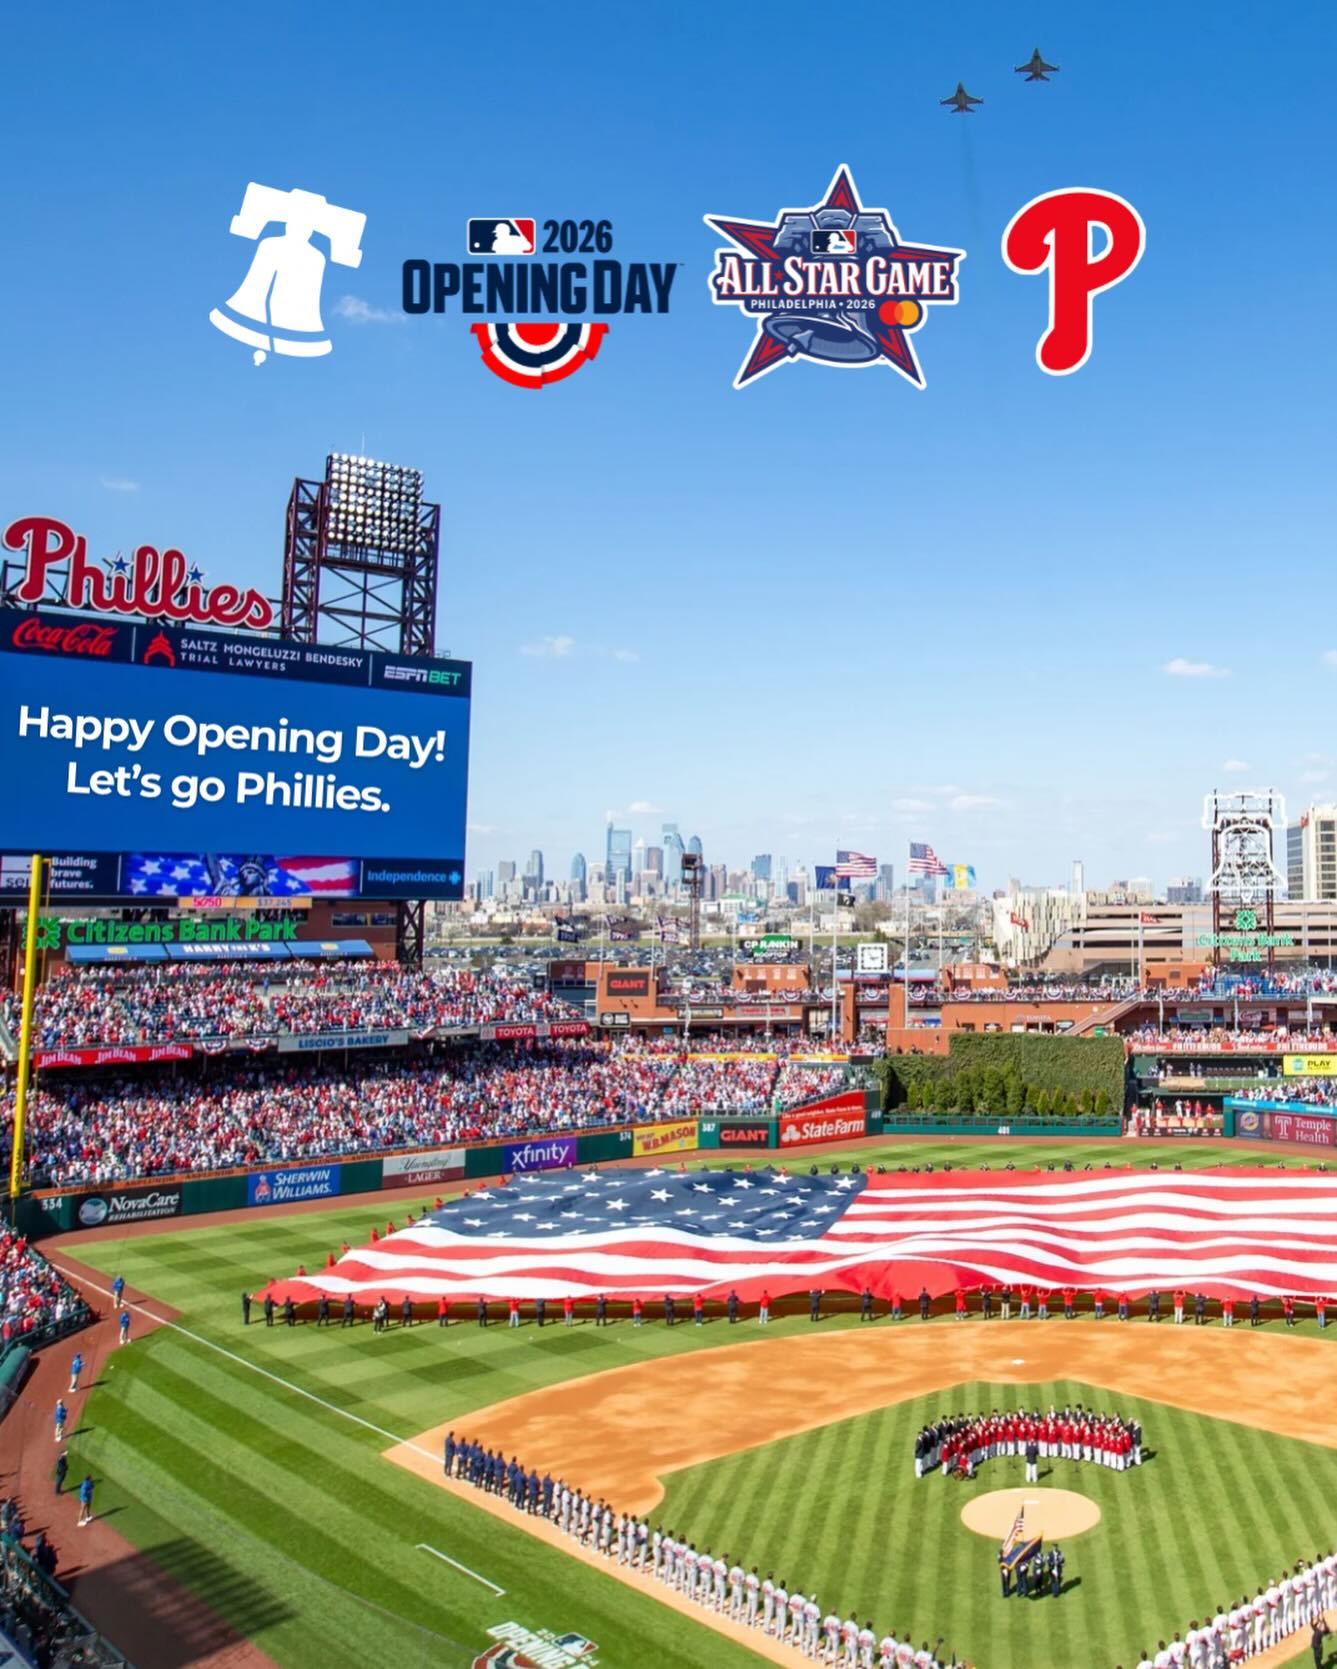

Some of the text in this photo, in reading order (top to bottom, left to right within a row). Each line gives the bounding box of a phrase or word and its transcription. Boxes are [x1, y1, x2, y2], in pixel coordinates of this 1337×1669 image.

[2, 516, 274, 629] Phillies
[180, 638, 363, 669] SALTZ MONGELUZZI BENDESKY
[180, 652, 287, 672] TRIAL LAWYERS
[18, 705, 446, 769] Happy Opening Day!
[171, 776, 226, 808] go
[236, 771, 391, 813] Phillies.
[51, 857, 98, 869] Building
[51, 868, 82, 877] brave
[368, 870, 446, 885] Independence
[50, 879, 94, 888] futures.
[66, 915, 298, 943] Citizens Bank Park
[1230, 950, 1262, 962] Park
[609, 979, 645, 989] GIANT
[498, 1026, 535, 1037] TOYOTA
[553, 1024, 587, 1034] TOYOTA
[298, 1034, 390, 1049] LISCIO'S BAKERY
[38, 1050, 81, 1068] JIM BEAM
[95, 1047, 136, 1065] JIM BEAM
[148, 1044, 189, 1061] JIM BEAM
[1295, 1117, 1331, 1133] Temple
[720, 1129, 768, 1142] GIANT
[1295, 1130, 1329, 1144] Health
[511, 1143, 570, 1169] xfinity
[274, 1170, 330, 1186] SHERWIN
[407, 1170, 441, 1184] LAGER
[108, 1191, 180, 1212] NovaCare
[107, 1207, 176, 1222] REHABILITATION
